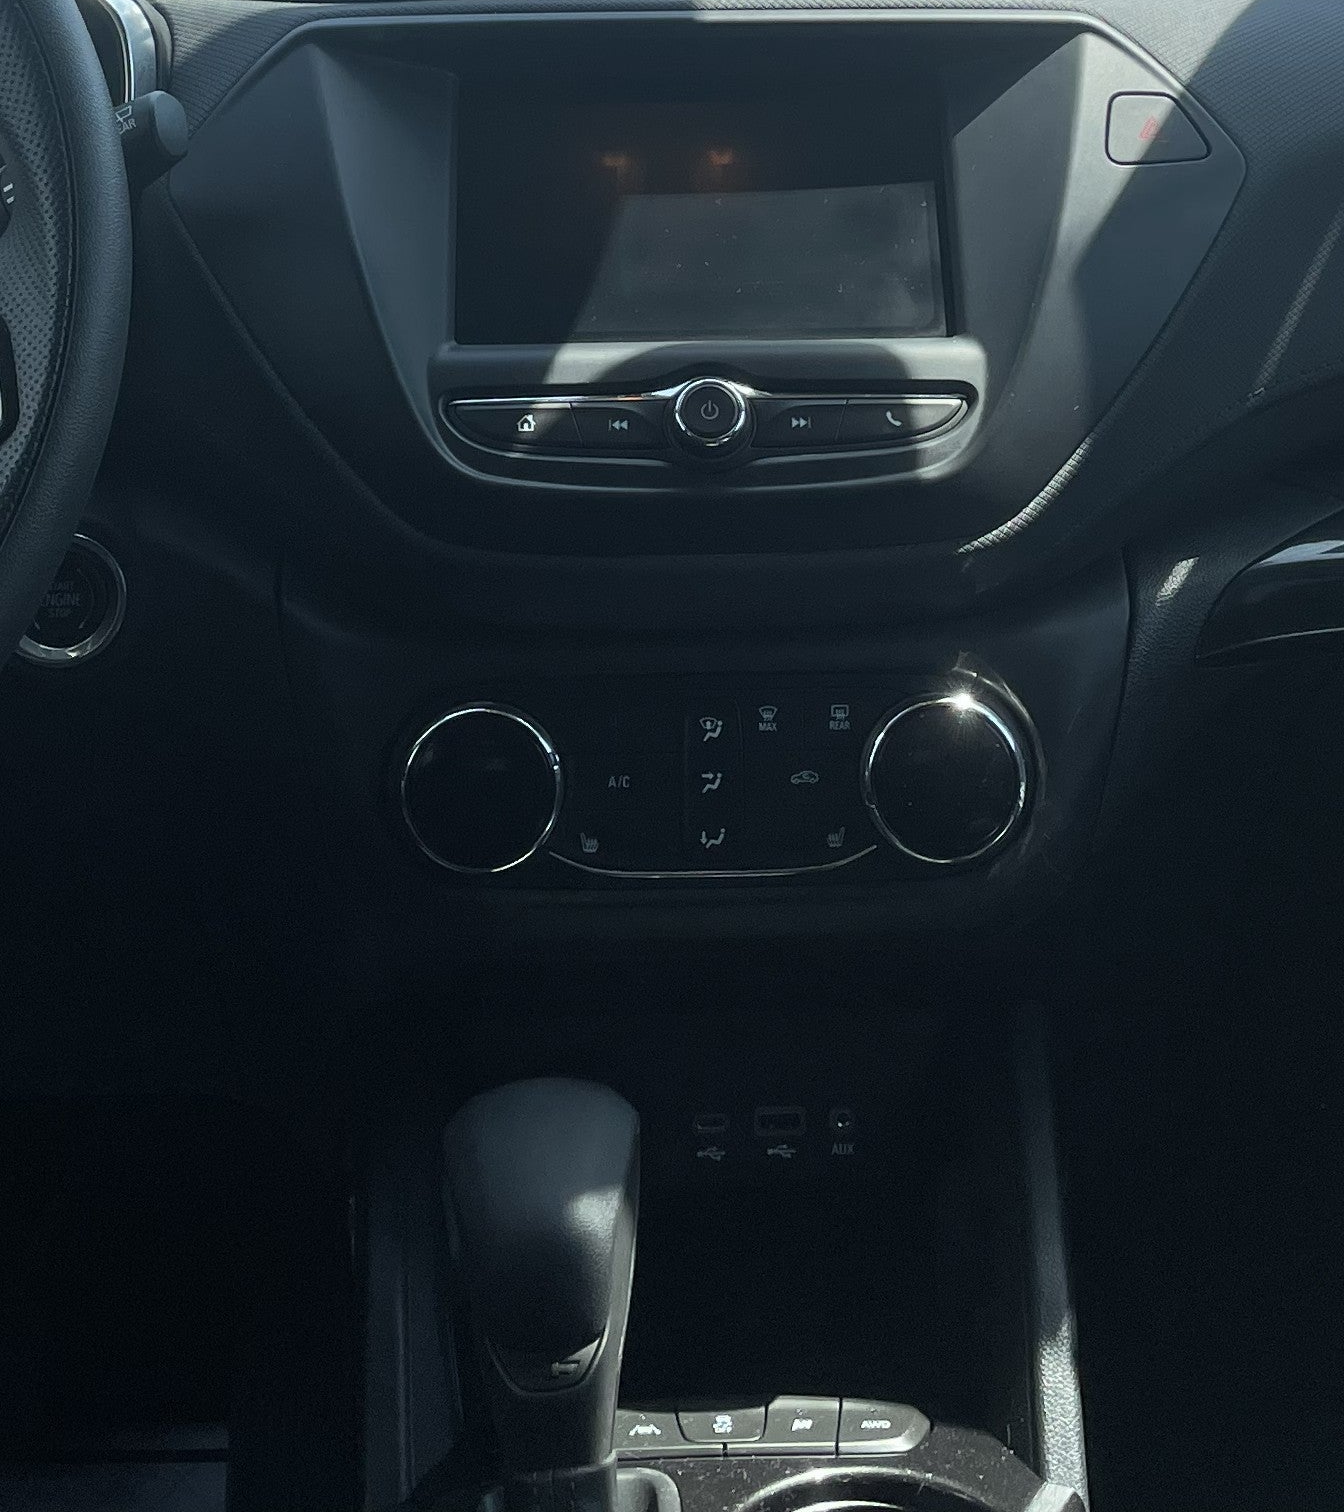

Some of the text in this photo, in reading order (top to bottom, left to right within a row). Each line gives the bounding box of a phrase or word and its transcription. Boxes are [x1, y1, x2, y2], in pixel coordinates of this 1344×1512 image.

[608, 774, 631, 789] A/C
[831, 1142, 856, 1156] AUX
[860, 1419, 892, 1430] AWD
